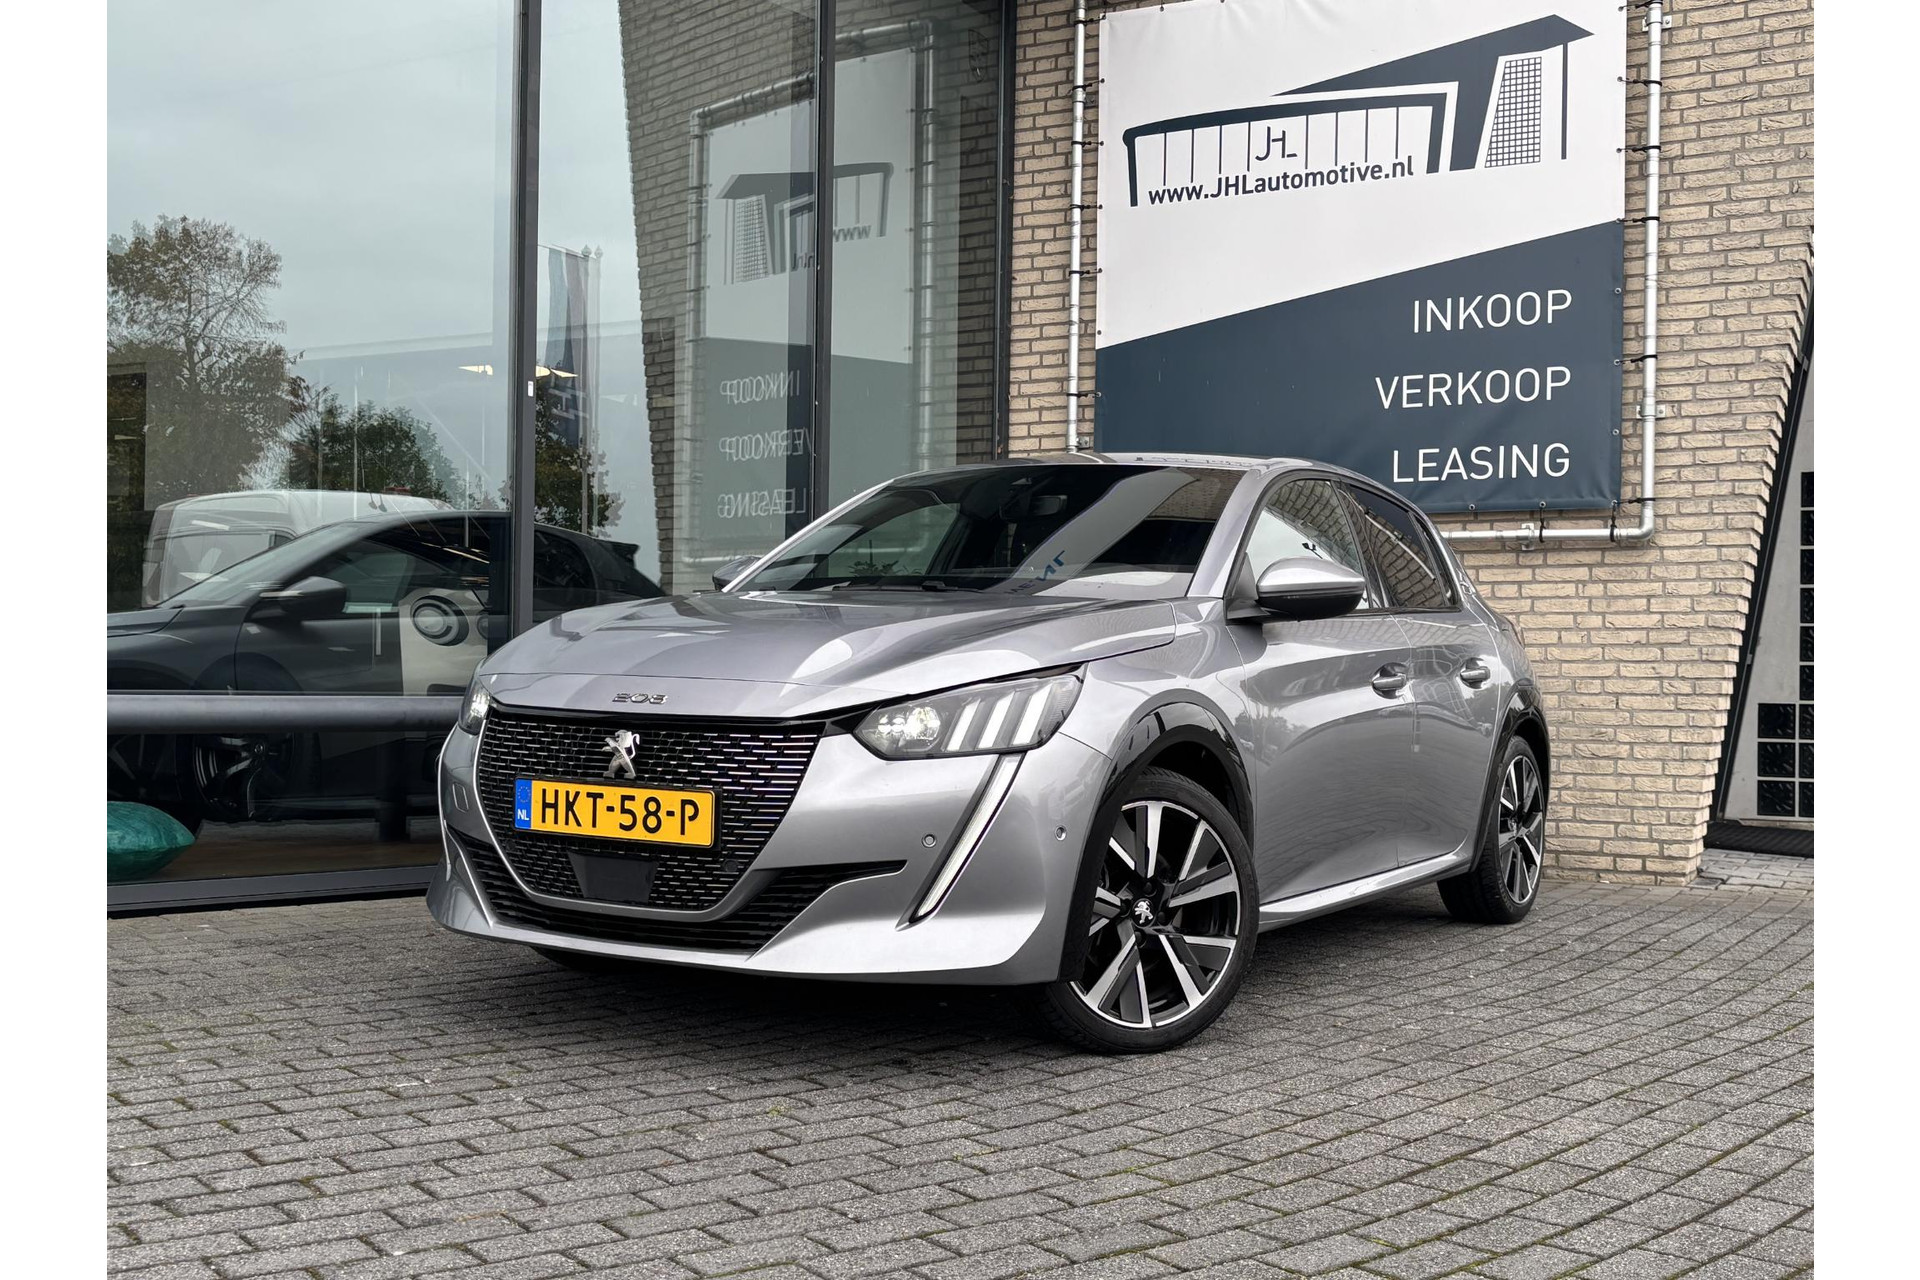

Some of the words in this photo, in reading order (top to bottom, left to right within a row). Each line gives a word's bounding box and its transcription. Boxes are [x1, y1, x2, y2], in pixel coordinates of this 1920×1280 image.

[1255, 126, 1298, 161] JHL
[1148, 155, 1414, 205] www.JHLautomotive.nl
[1413, 289, 1572, 333] INKOOP
[1374, 366, 1571, 410] VERKOOP
[1393, 442, 1570, 483] LEASING
[612, 692, 668, 705] 208
[517, 808, 530, 821] NL
[541, 787, 700, 836] HKT-58-P
